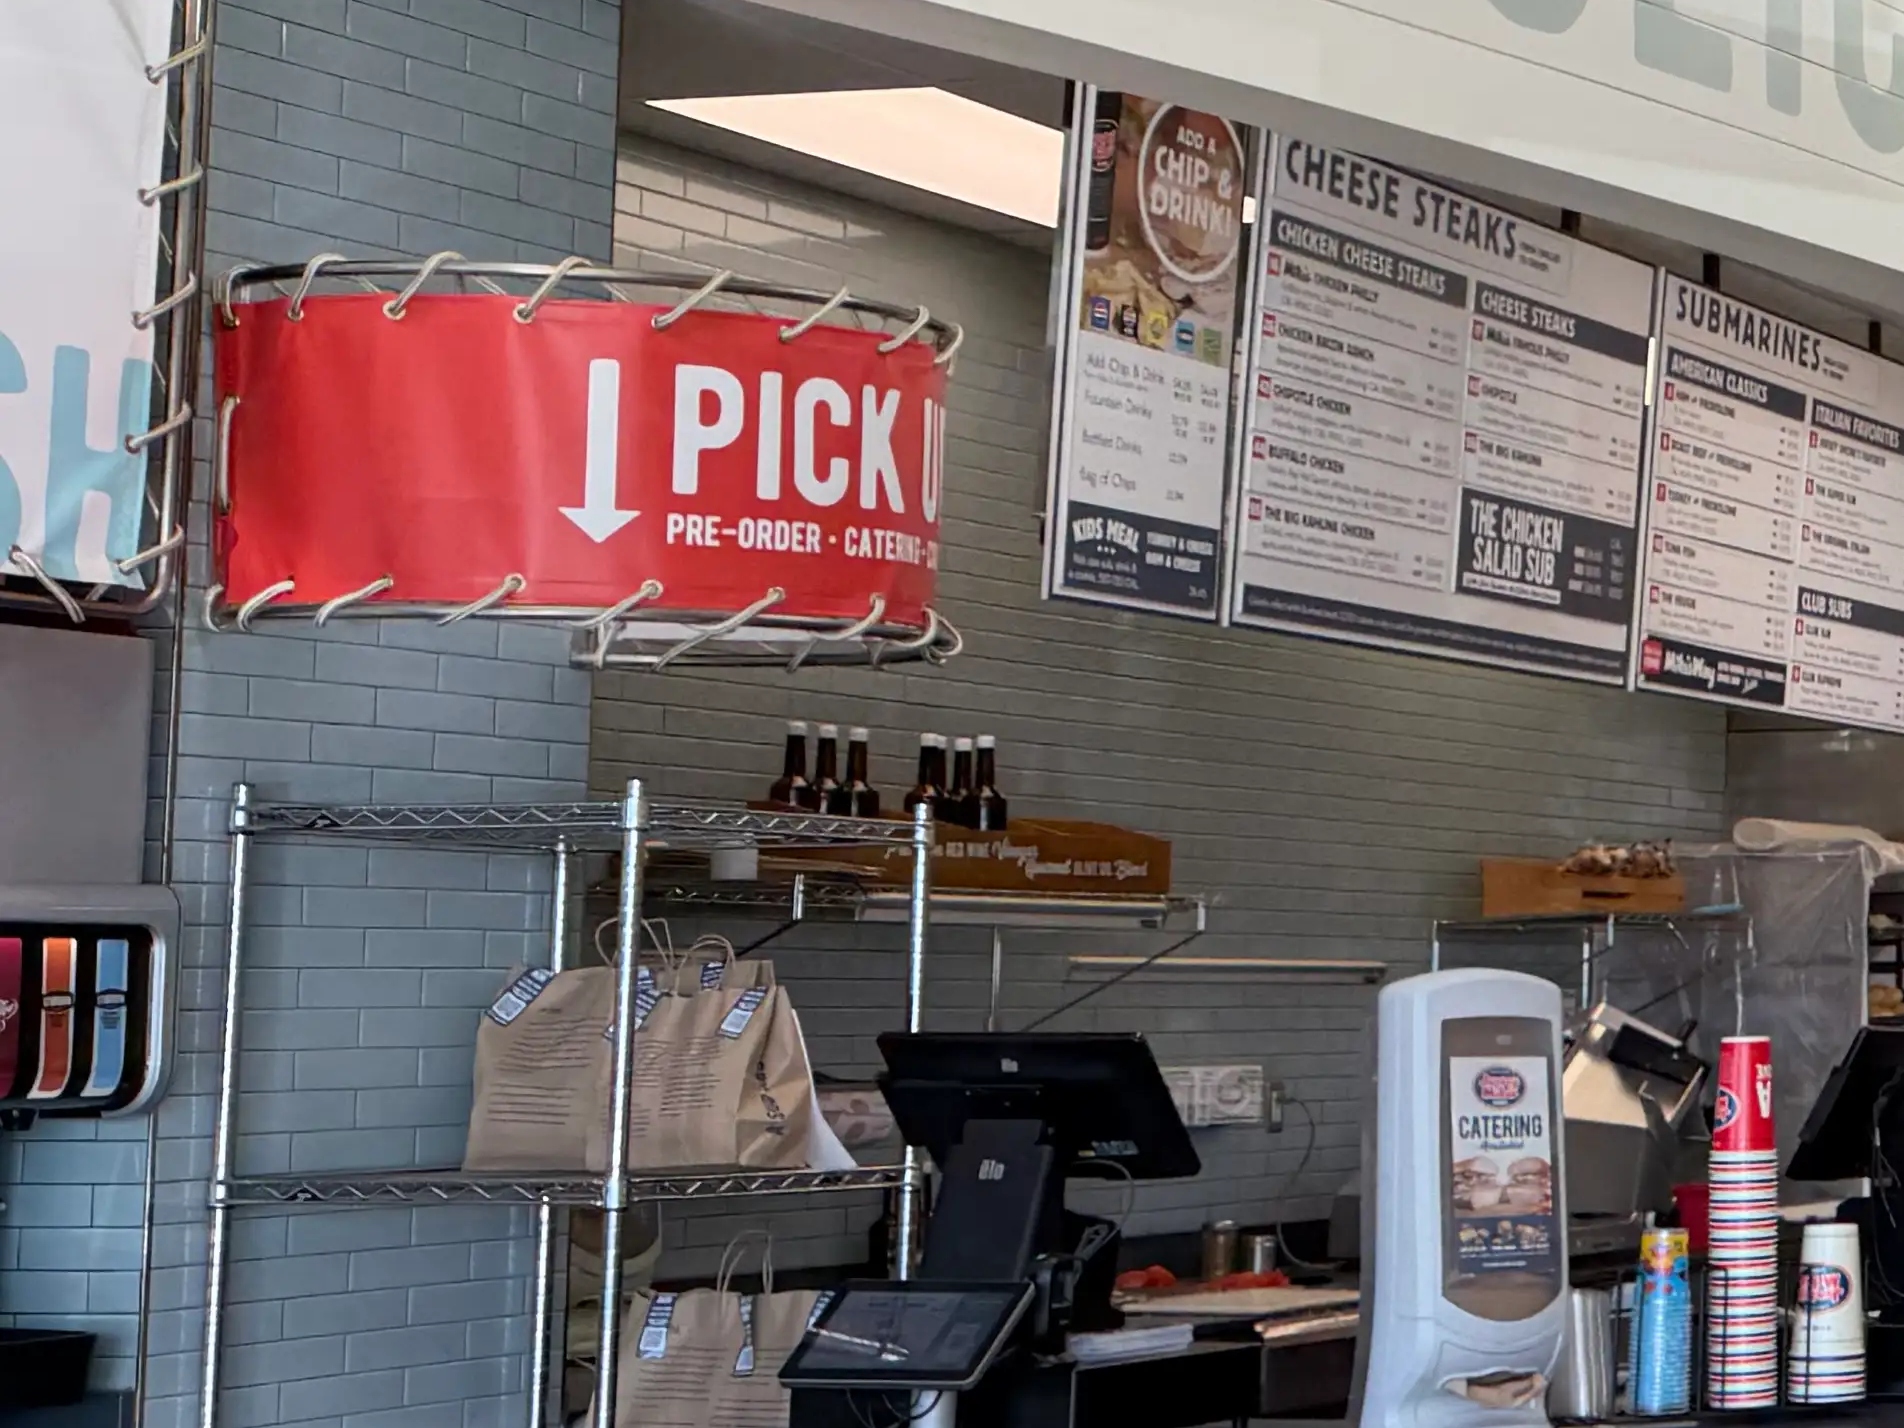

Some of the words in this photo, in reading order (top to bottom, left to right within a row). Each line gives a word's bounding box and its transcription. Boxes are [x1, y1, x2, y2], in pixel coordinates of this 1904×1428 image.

[1177, 126, 1204, 149] ADD
[1155, 146, 1210, 189] CHIP
[1219, 169, 1232, 200] &
[1286, 140, 1401, 219] CHEESE
[1413, 185, 1519, 260] STEAKS
[1277, 219, 1339, 262] CHICKEN
[1343, 243, 1393, 279] CHEESE
[1398, 261, 1446, 296] STEAKS
[1481, 290, 1528, 322] CHEESE
[1531, 306, 1576, 338] STEAKS
[1676, 285, 1821, 373] SUBMARINES
[1671, 353, 1724, 389] AMERICAN
[1726, 373, 1769, 403] CLASSICS
[672, 363, 905, 514] PICK
[921, 397, 946, 523] U
[1815, 404, 1852, 431] ITALIAN
[1853, 417, 1899, 448] FAVORITES
[666, 512, 821, 554] PRE-ORDER
[844, 525, 921, 565] CATERING
[1072, 517, 1104, 544] KIDS
[1107, 518, 1140, 553] MEAL
[1470, 499, 1499, 537] THE
[1501, 506, 1564, 553] CHICKEN
[1472, 536, 1522, 579] SALAD
[1525, 548, 1555, 586] SUB
[1801, 591, 1826, 614] CLUB
[1828, 596, 1853, 620] SUBS
[1459, 1114, 1542, 1139] CATERING
